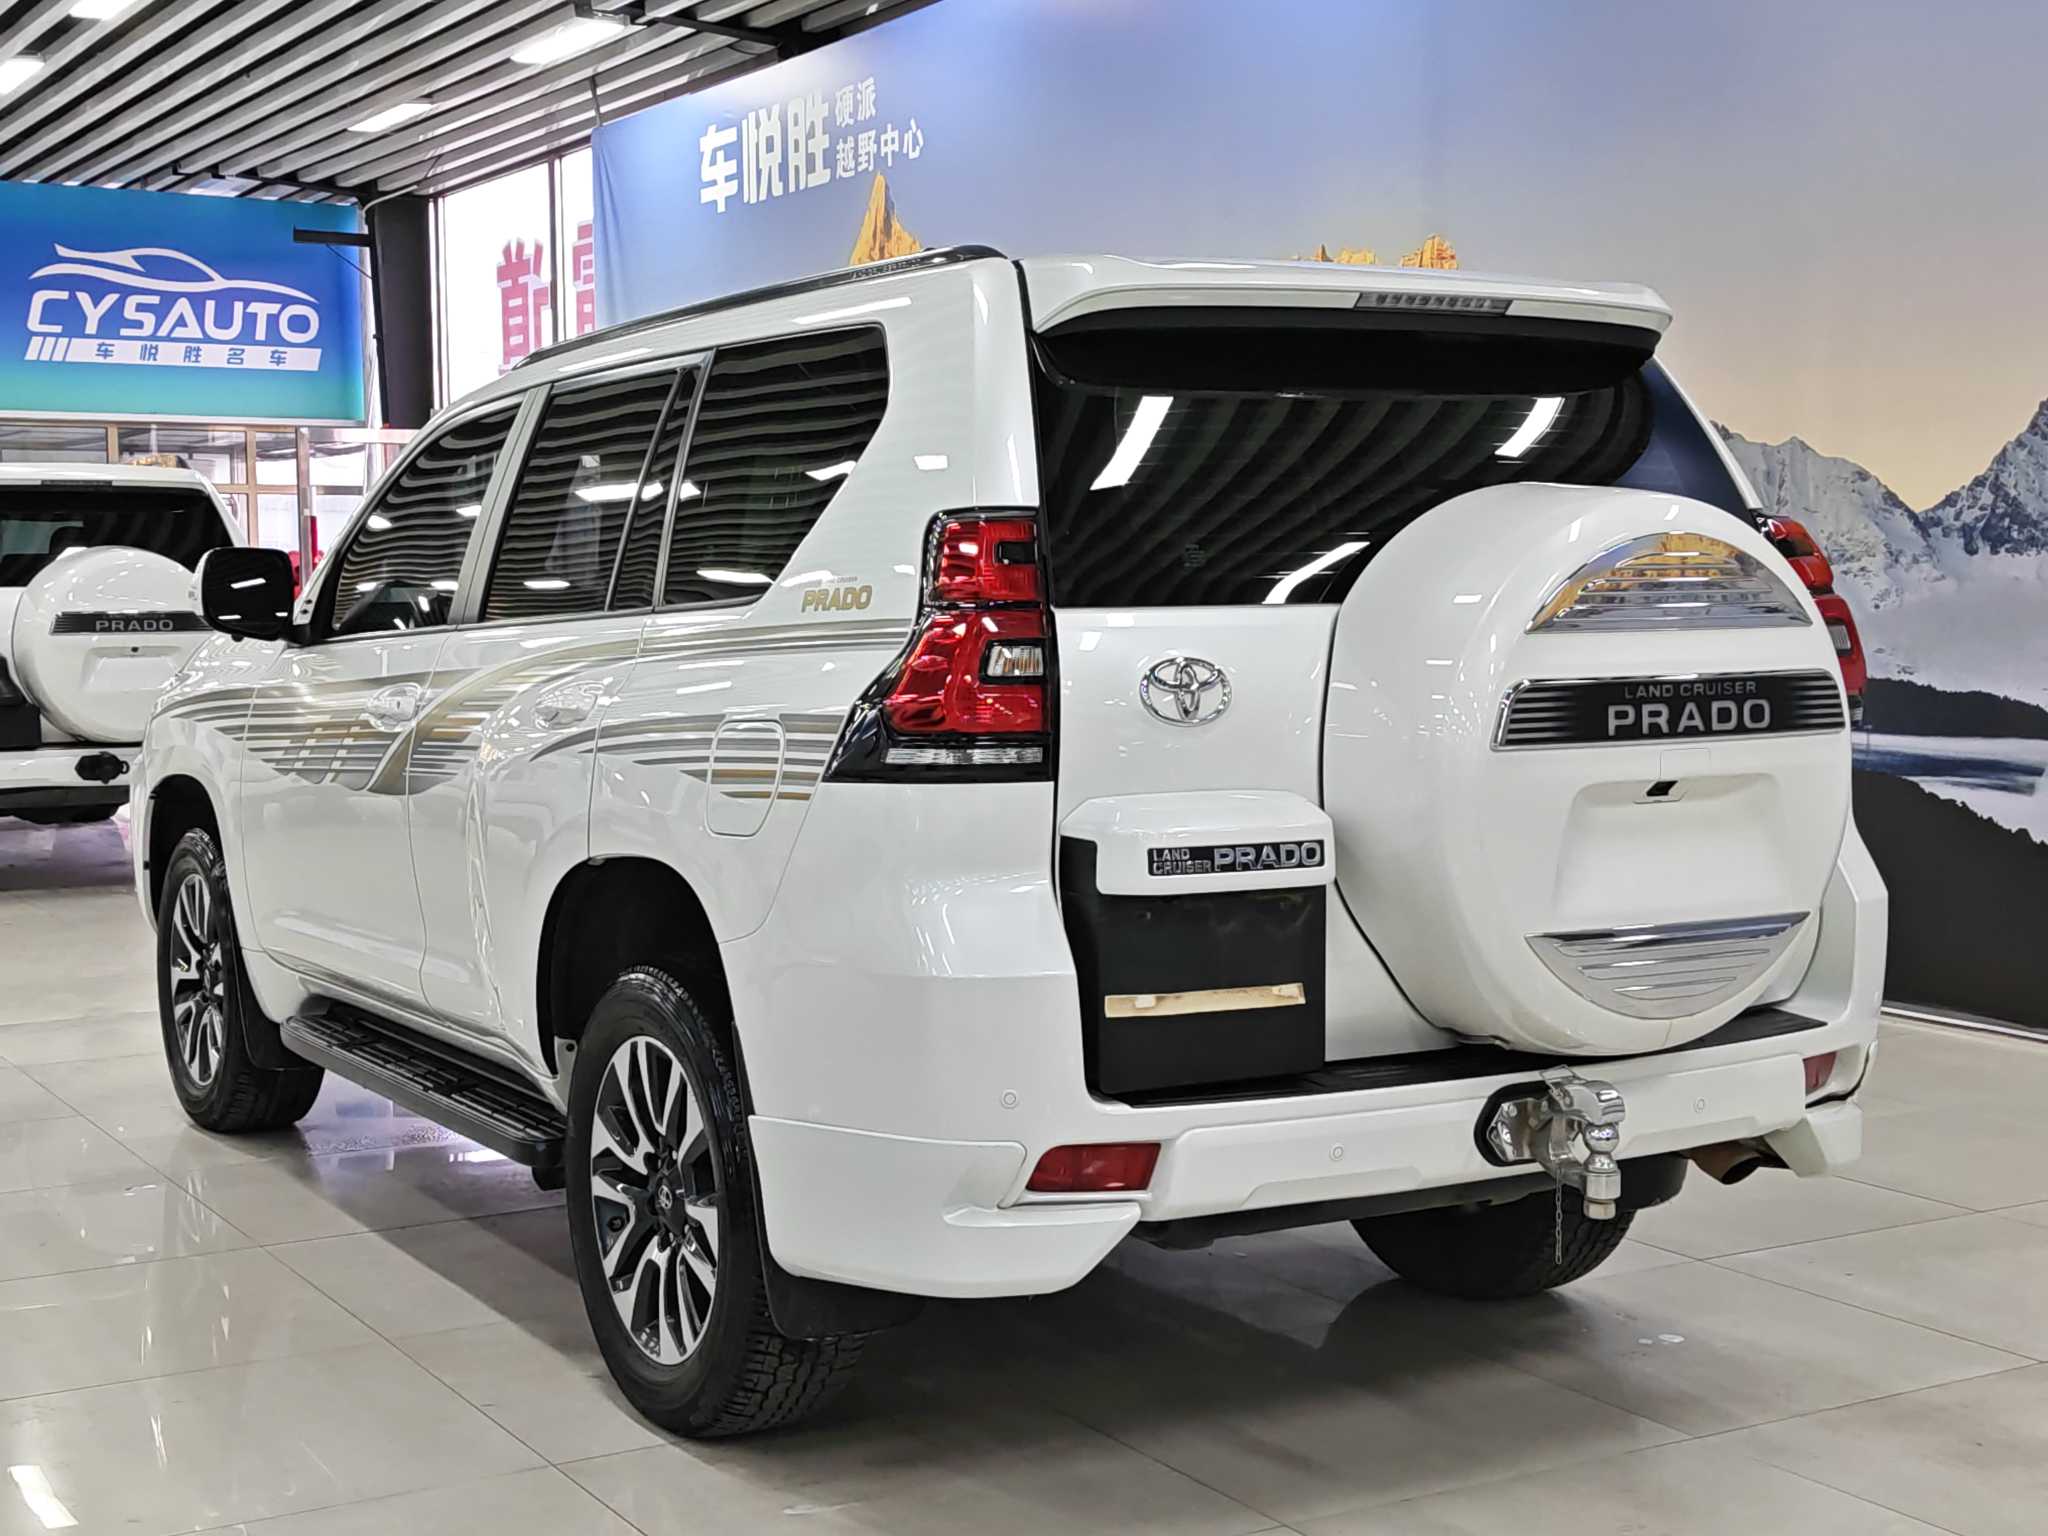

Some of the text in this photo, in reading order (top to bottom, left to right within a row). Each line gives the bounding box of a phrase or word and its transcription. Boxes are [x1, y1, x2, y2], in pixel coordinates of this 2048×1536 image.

[835, 76, 877, 128] 硬派
[699, 90, 831, 213] 车悦胜
[836, 117, 924, 180] 越野中心
[26, 289, 320, 344] CYSAUTO
[95, 342, 288, 366] 车悦胜名车
[802, 585, 872, 612] PRADO
[96, 620, 173, 631] PRADO
[1624, 680, 1757, 699] LAND CRUISER
[1607, 698, 1771, 736] PRADO
[1152, 848, 1212, 875] LAND CRUISER
[1214, 842, 1321, 872] PRADO
